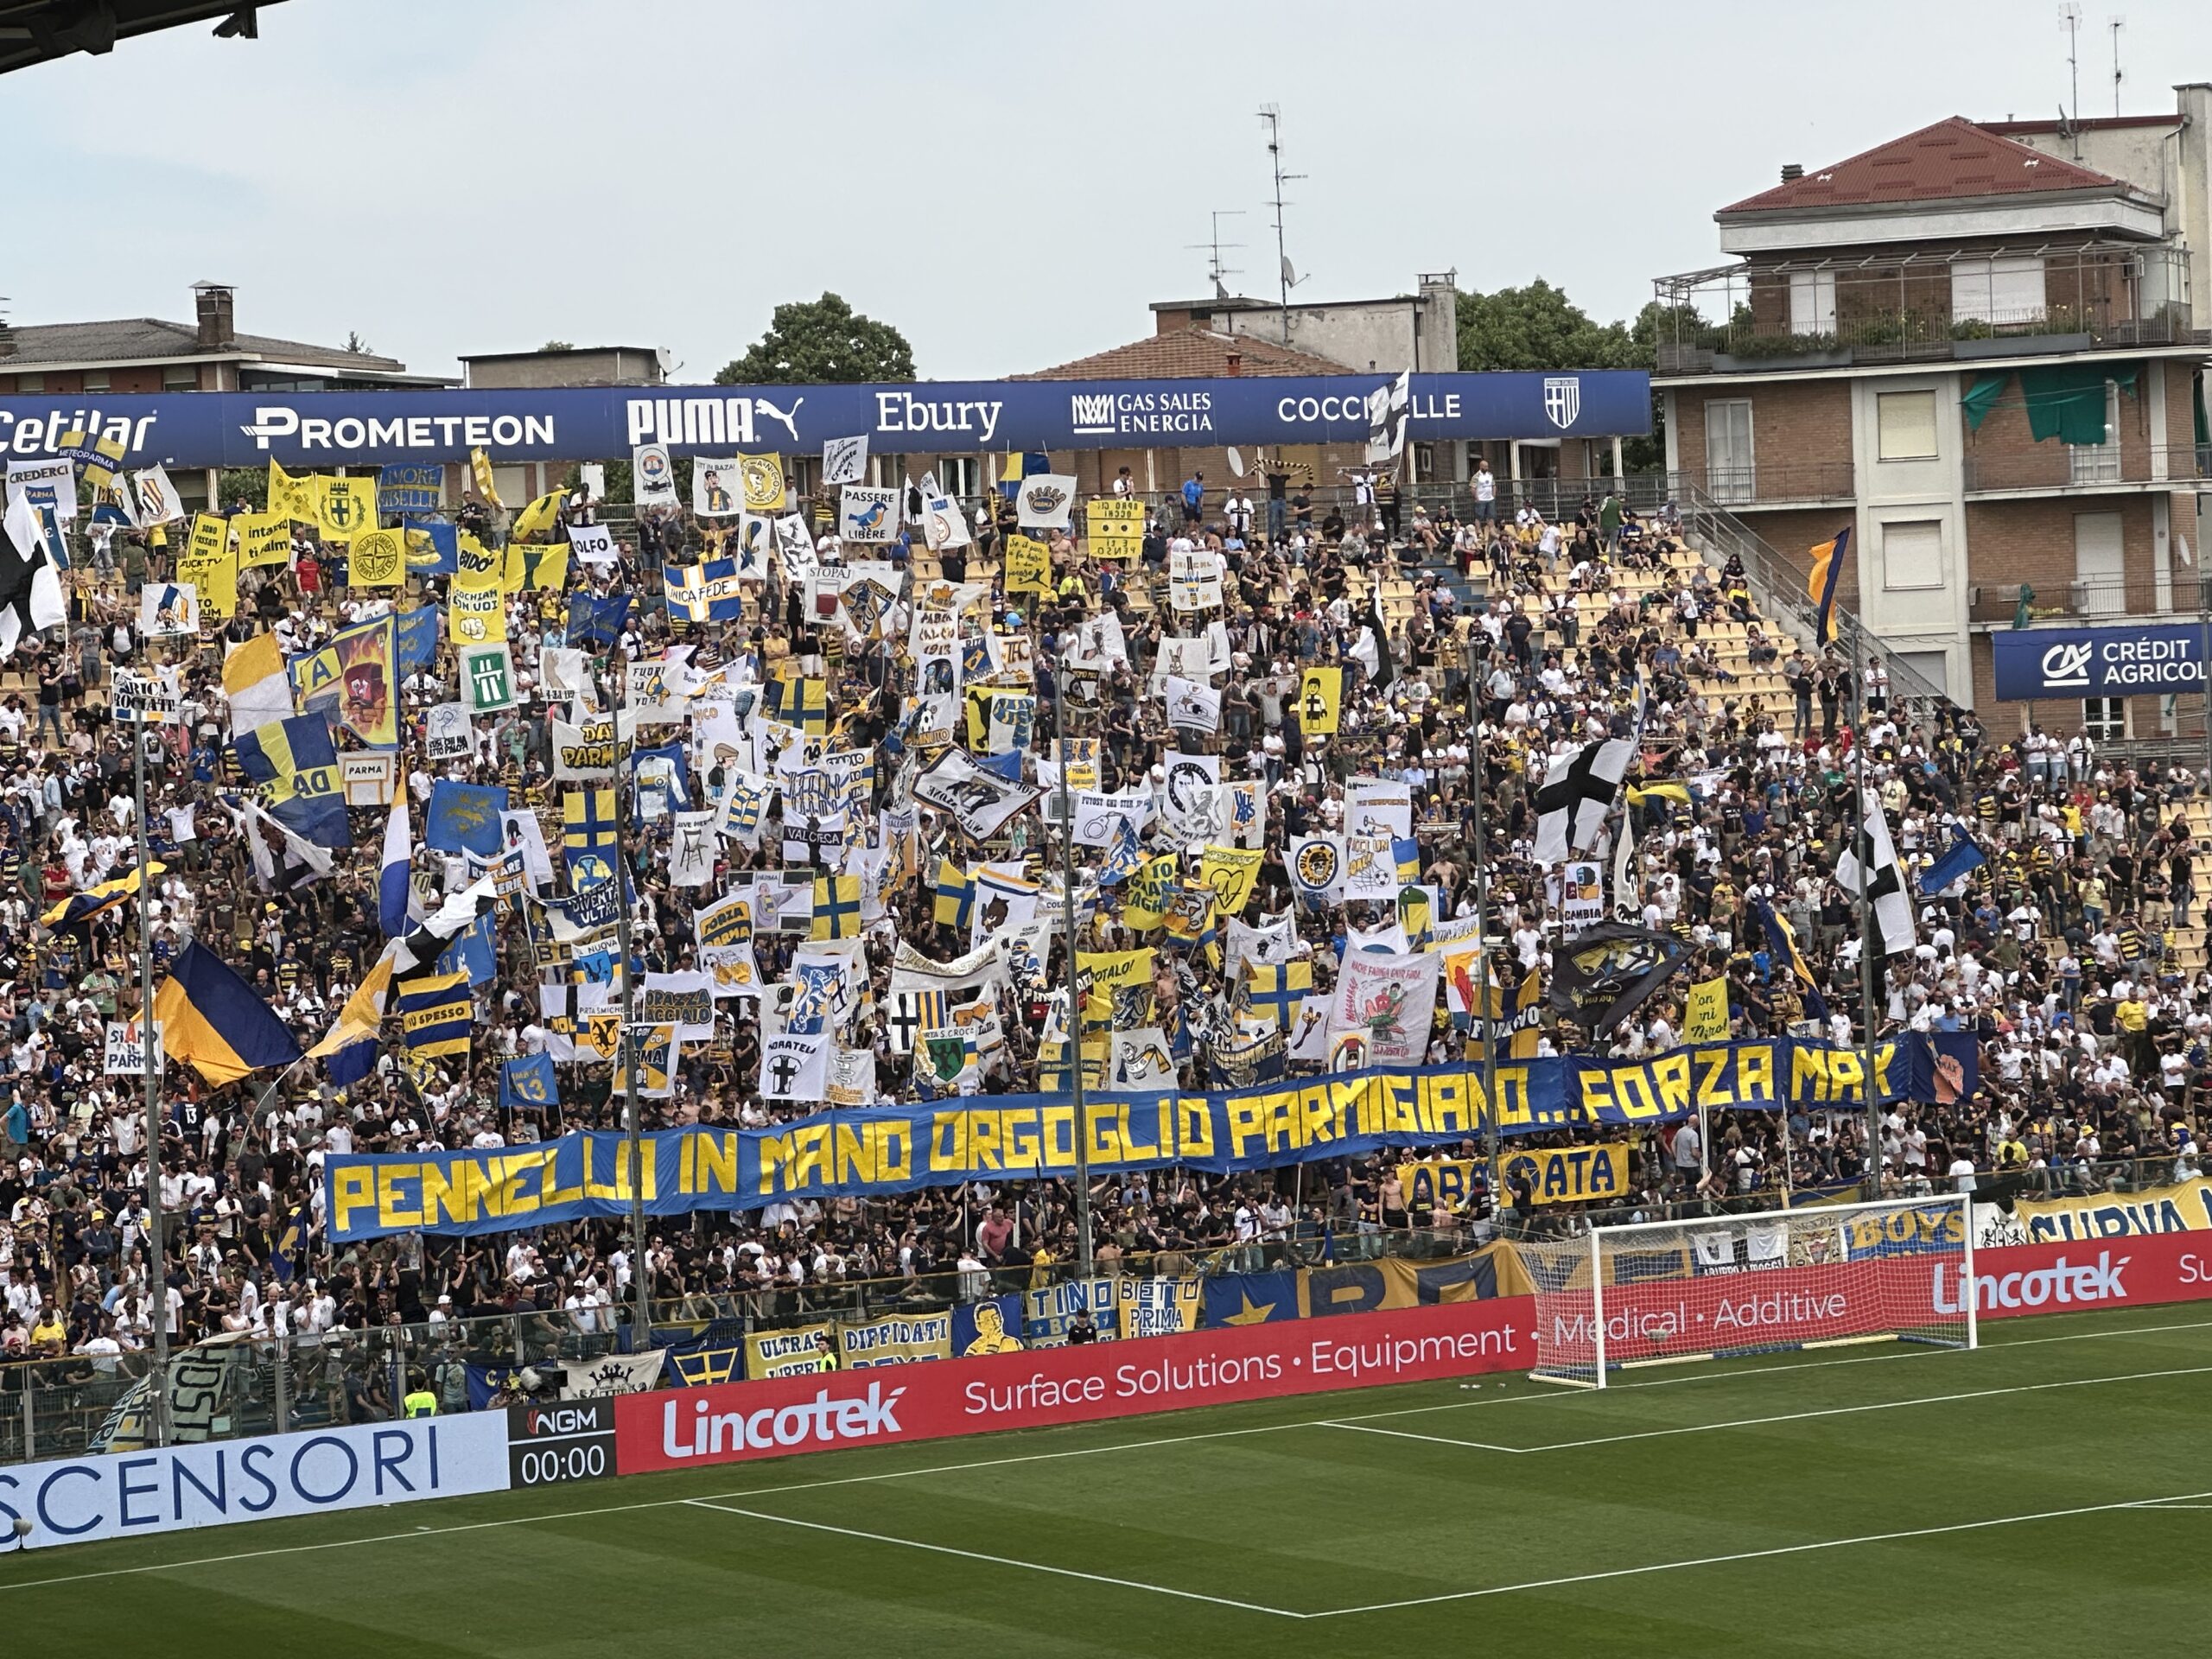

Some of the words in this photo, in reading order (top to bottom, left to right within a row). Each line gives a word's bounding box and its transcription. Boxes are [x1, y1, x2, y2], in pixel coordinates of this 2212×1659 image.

[1117, 393, 1154, 412] GAS
[1160, 392, 1211, 411] SALES
[1278, 393, 1461, 423] COCCILLE
[627, 398, 754, 445] PUMA
[875, 391, 1002, 442] Ebury
[1121, 414, 1213, 433] ENERGIA
[240, 407, 554, 449] PROMETEON
[58, 449, 115, 470] METEOPARMA
[10, 464, 69, 484] CREDERCI
[844, 489, 894, 503] PASSERE
[848, 529, 886, 540] LIBERE
[698, 580, 730, 601] FEDE
[2102, 637, 2191, 662] CRÉDIT
[2103, 661, 2210, 684] AGRICOL
[349, 764, 382, 777] PARMA
[704, 907, 744, 935] FORZA
[1565, 908, 1602, 922] CAMBIA
[587, 941, 618, 953] NUOVA
[418, 1007, 466, 1025] SPESSO
[127, 1044, 139, 1055] IL
[185, 1107, 198, 1123] 13
[334, 1136, 658, 1233] PENNELLO
[680, 1133, 738, 1195] IN
[760, 1120, 912, 1196] MANO
[930, 1097, 1215, 1173] ORGOGLIO
[1580, 1046, 1775, 1123] FORZA
[1791, 1044, 1897, 1103] MAX
[1851, 1206, 1965, 1250] BOYS
[1031, 1279, 1114, 1319] TINO
[1120, 1281, 1199, 1303] BIETTO
[1050, 1313, 1100, 1334] BOS
[1129, 1308, 1185, 1329] PRIMA
[758, 1331, 823, 1361] ULTRAS
[845, 1319, 947, 1353] DIFFIDATI
[965, 1372, 1105, 1415] Surface
[1116, 1352, 1281, 1397] Solutions
[1312, 1324, 1517, 1377] Equipment
[1556, 1301, 1687, 1346] Medical
[1713, 1289, 1847, 1330] Additive
[535, 1407, 597, 1435] NGM
[664, 1381, 907, 1459] Lincotek
[522, 1445, 605, 1484] 00:00
